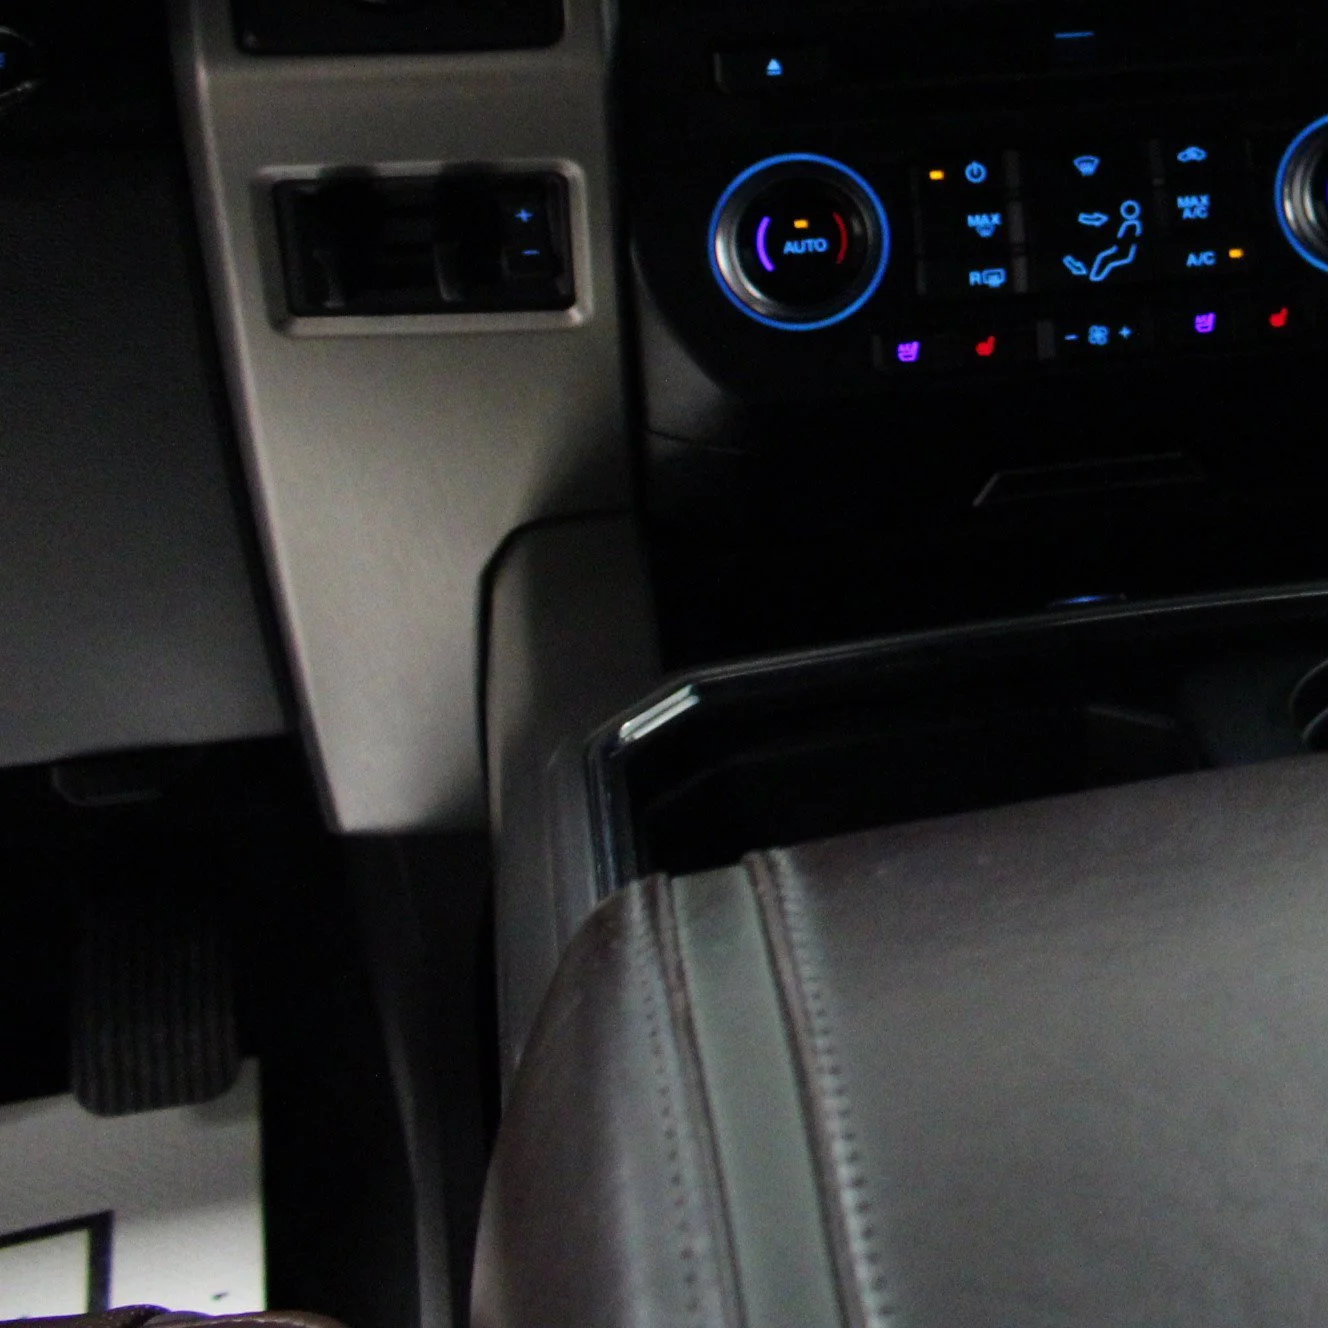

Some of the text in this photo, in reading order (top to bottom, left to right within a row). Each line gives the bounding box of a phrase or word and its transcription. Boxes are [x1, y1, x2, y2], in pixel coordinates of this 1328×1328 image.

[1177, 195, 1210, 208] MAX
[1182, 206, 1209, 219] A/C
[967, 213, 1001, 227] MAX
[783, 238, 828, 254] AUTO
[1186, 251, 1216, 266] A/C
[969, 271, 981, 286] R
